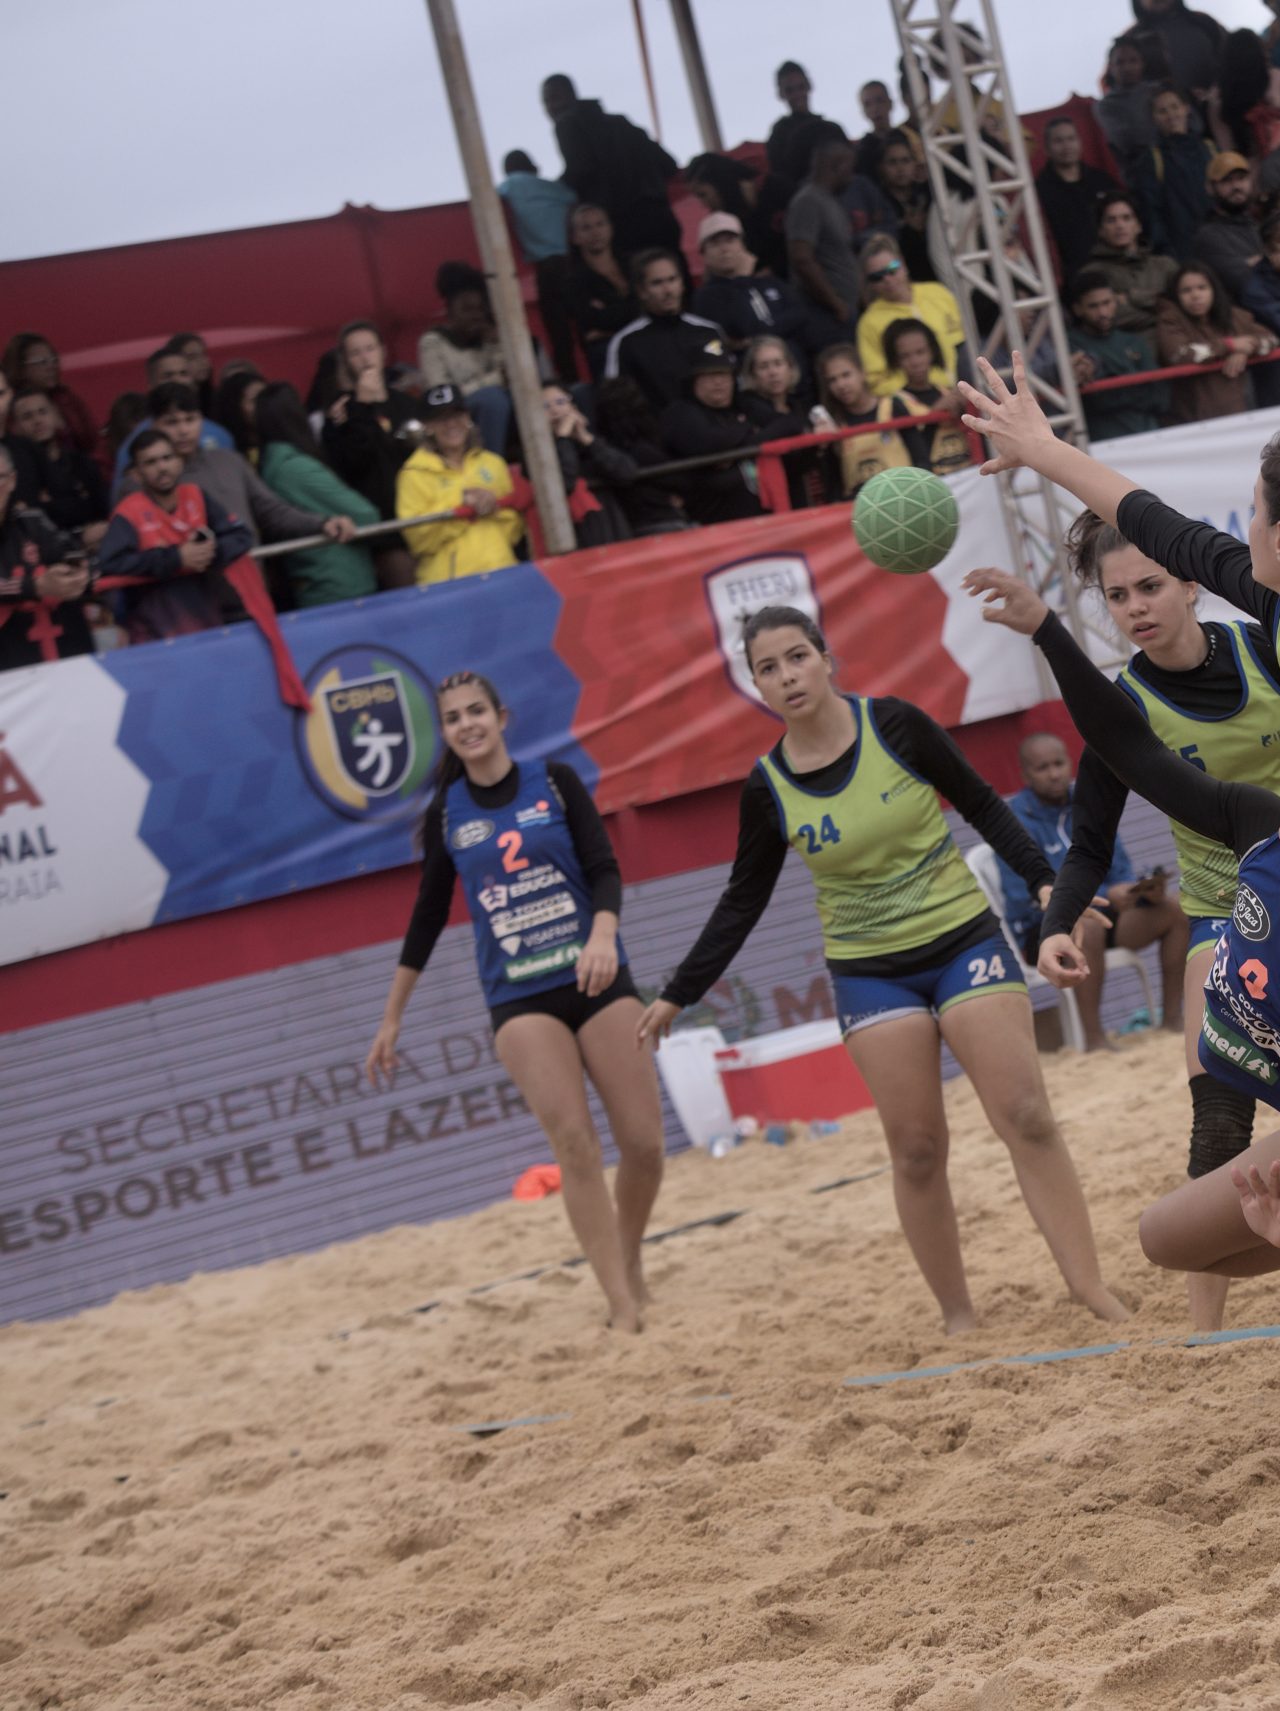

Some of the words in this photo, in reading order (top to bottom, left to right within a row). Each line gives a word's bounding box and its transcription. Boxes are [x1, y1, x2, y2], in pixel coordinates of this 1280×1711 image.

[496, 830, 530, 874] 2
[797, 813, 841, 854] 24
[967, 954, 1007, 987] 24
[55, 1050, 429, 1175] SECRETARA
[0, 1143, 282, 1256] ESPORTE
[294, 1129, 343, 1176] E
[346, 1078, 533, 1161] LAZER
